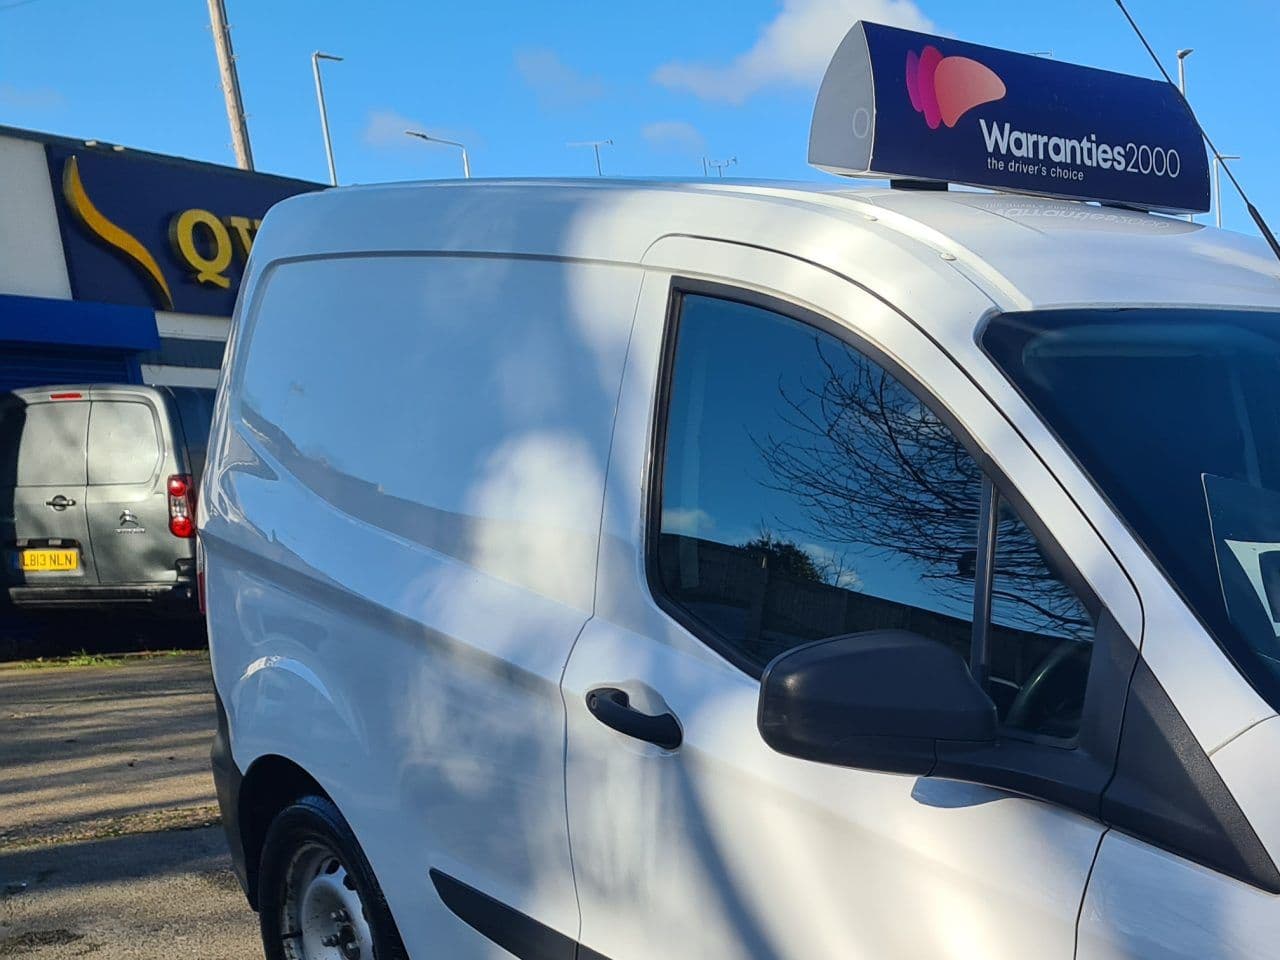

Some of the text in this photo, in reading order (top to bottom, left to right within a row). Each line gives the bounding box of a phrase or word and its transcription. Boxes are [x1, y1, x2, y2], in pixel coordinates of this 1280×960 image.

[979, 118, 1181, 178] Warranties2000
[987, 157, 1084, 181] the driver's choice
[22, 553, 73, 567] LB13 NLN
